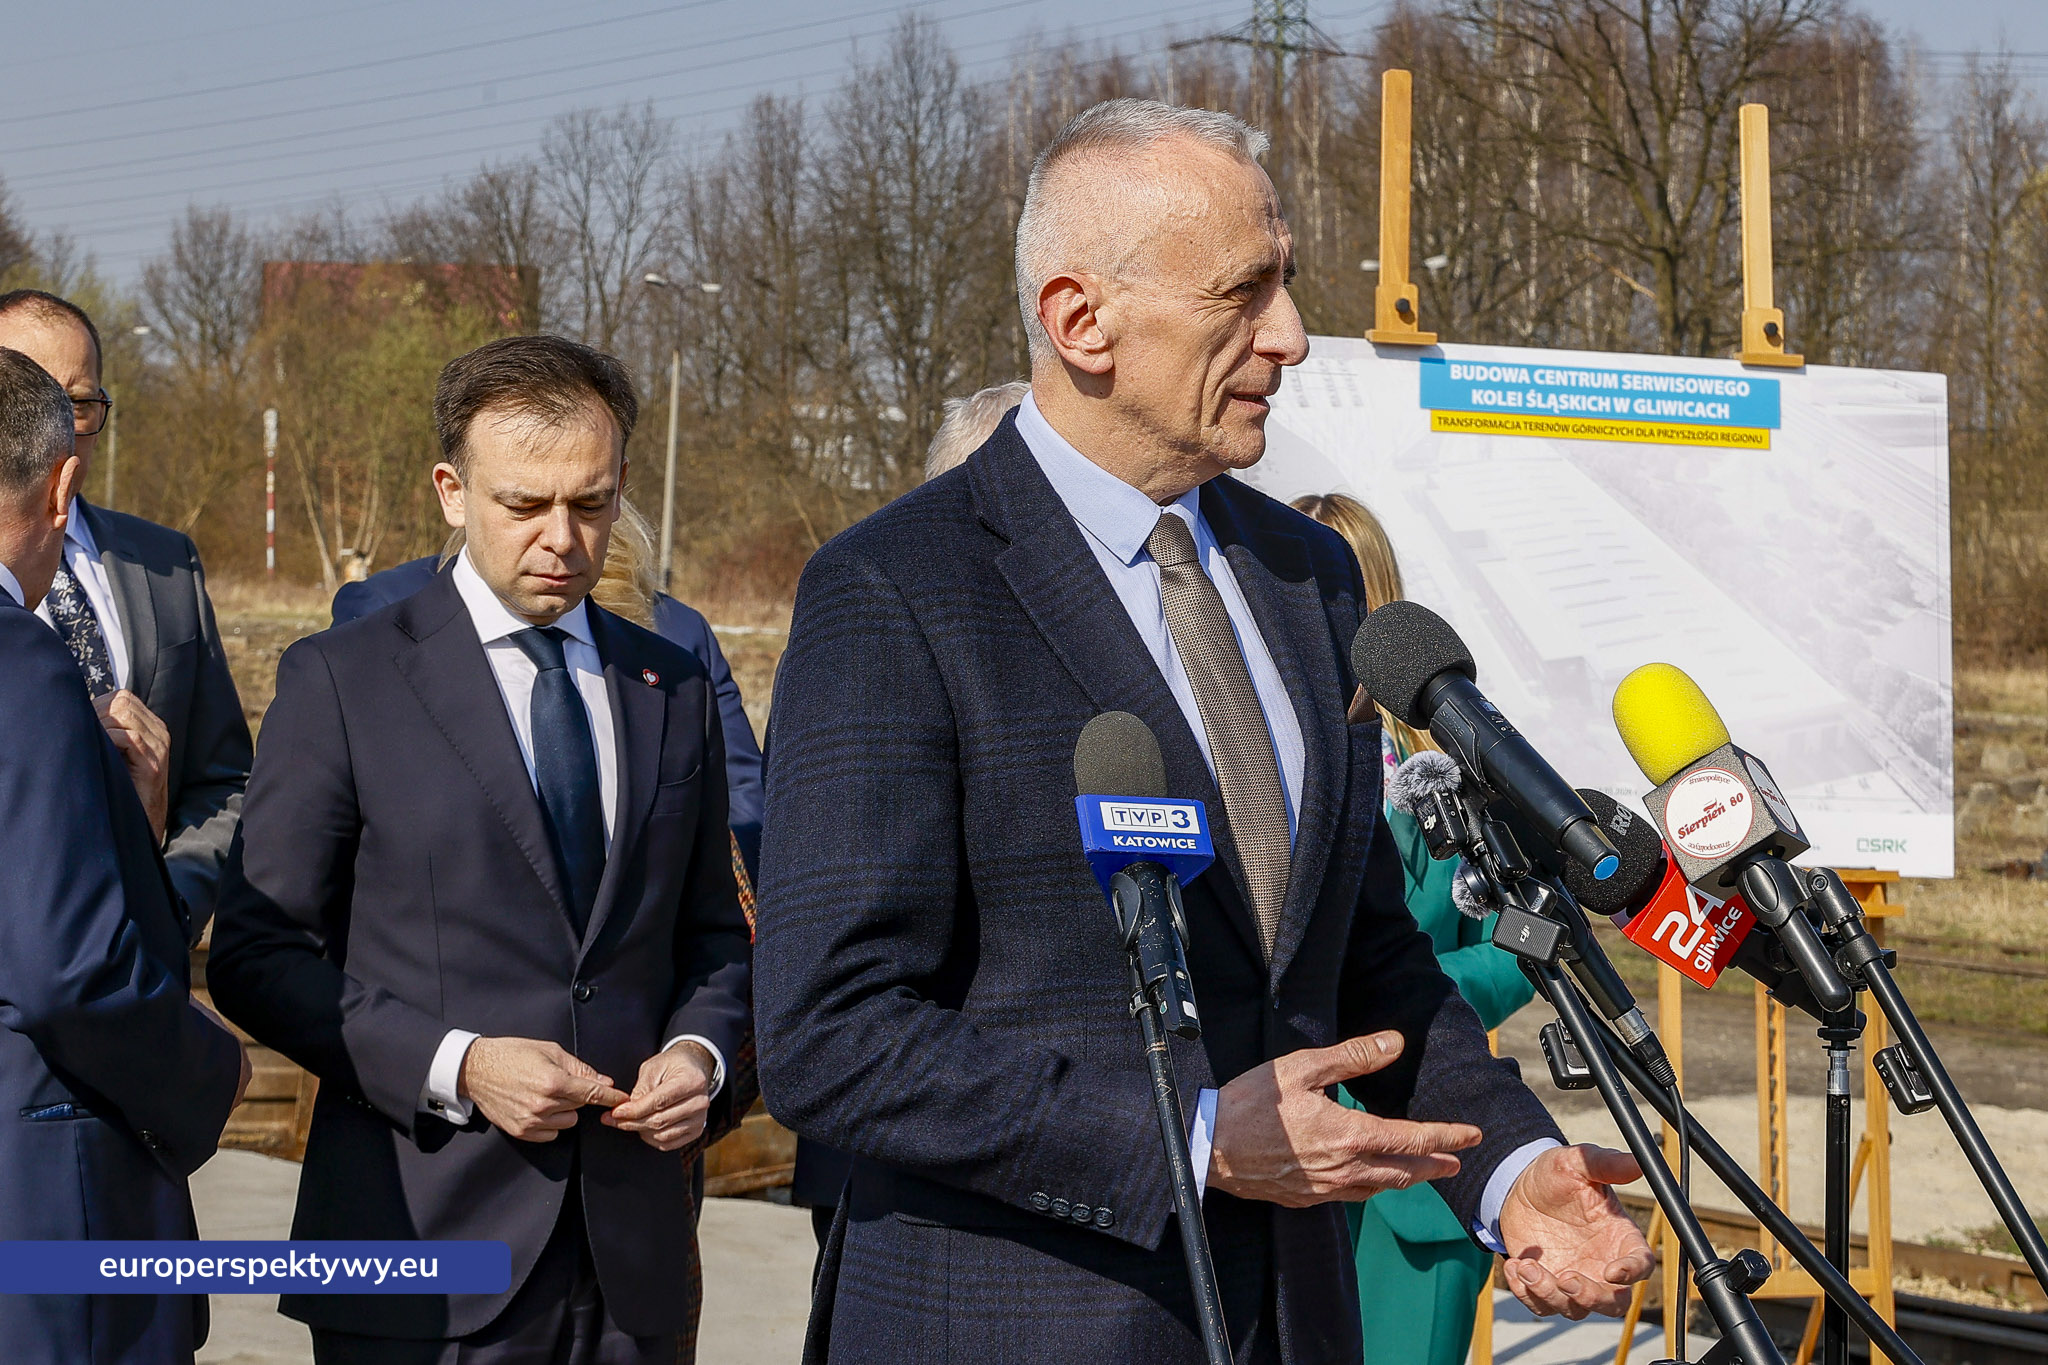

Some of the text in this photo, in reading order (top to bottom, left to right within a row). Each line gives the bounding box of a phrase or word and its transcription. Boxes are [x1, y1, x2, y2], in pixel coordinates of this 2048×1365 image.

[1450, 364, 1750, 397] BUDOWA CENTRUM SERWISOWEGO
[1472, 388, 1730, 419] KOLEI ŚLĄSKICH W GLIWICACH
[1438, 416, 1763, 444] TRANSFORMACJA TERENÓW GÓRNICZYCH DLA PRZYSZŁOŚCI REGIONU
[1678, 802, 1726, 839] Sierpień
[1729, 792, 1744, 807] 80
[1113, 835, 1197, 849] KATOWICE
[1651, 883, 1726, 960] 24
[1693, 906, 1743, 973] gliwice
